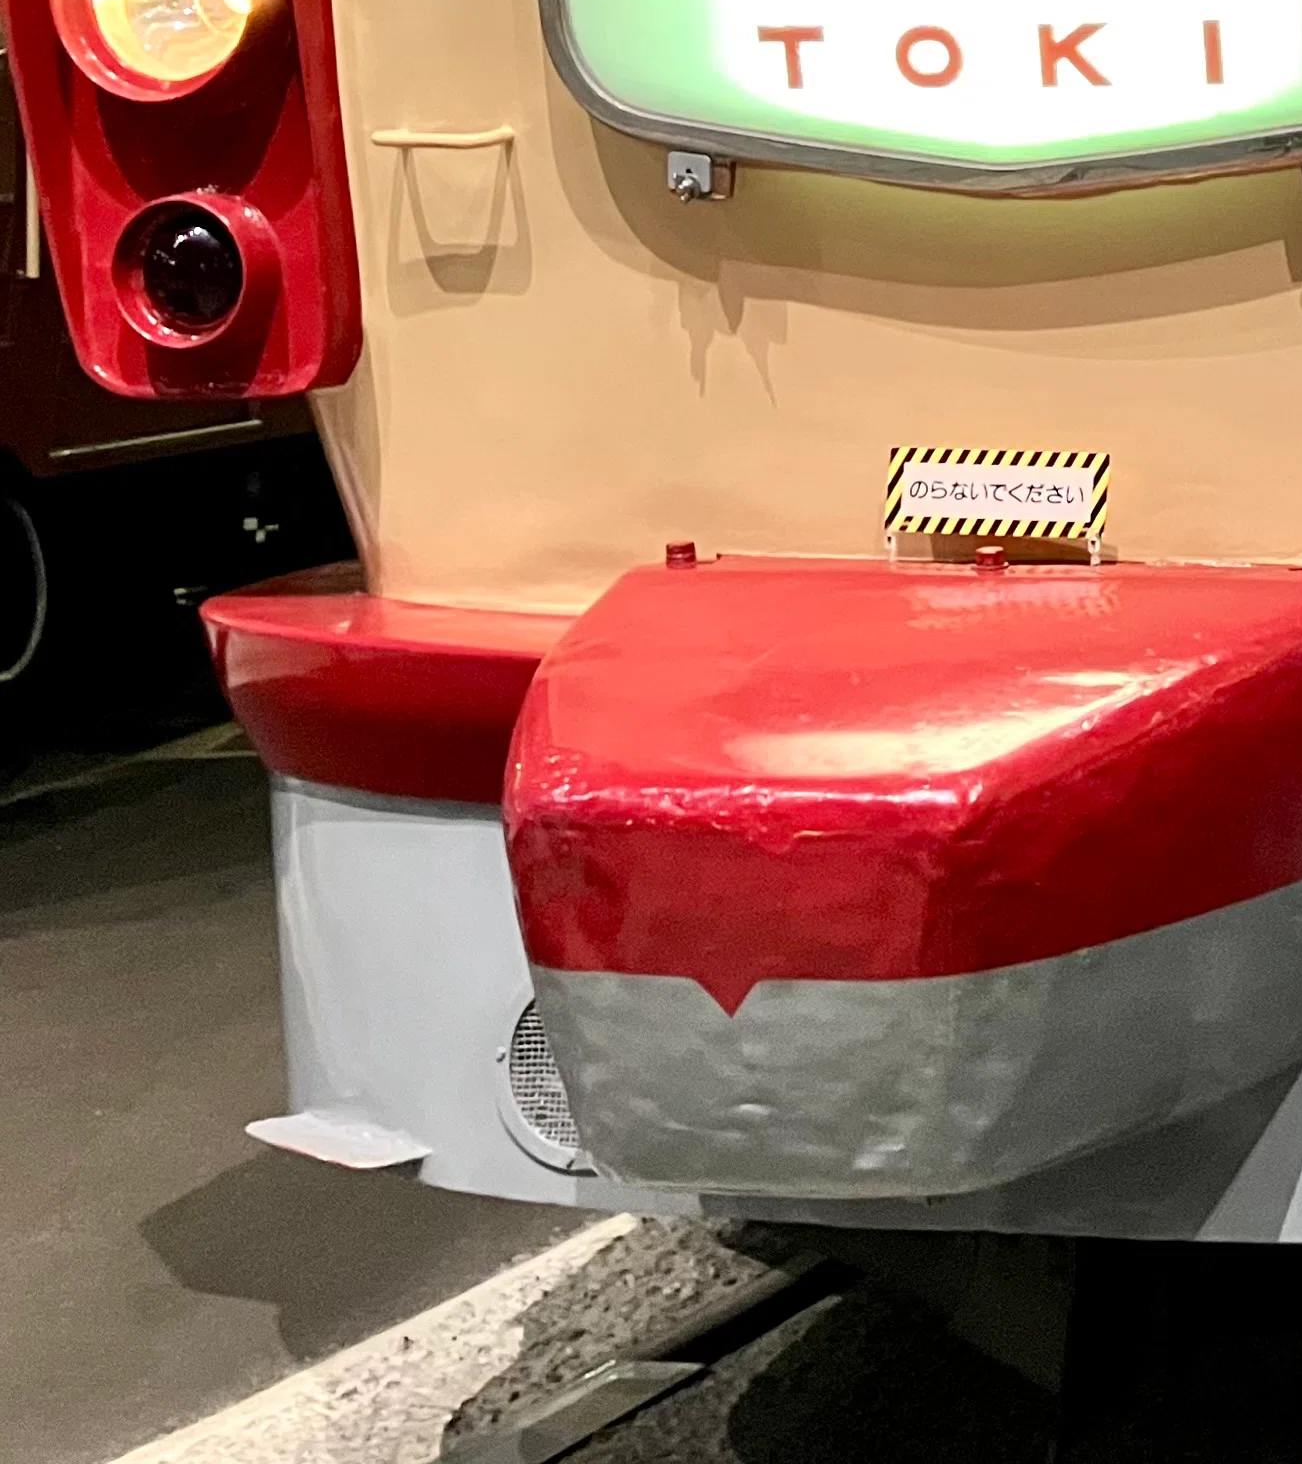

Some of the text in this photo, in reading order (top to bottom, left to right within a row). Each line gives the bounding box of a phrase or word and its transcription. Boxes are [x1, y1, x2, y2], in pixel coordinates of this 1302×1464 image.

[757, 19, 1224, 89] TOKI
[908, 480, 1085, 504] のらないでください
